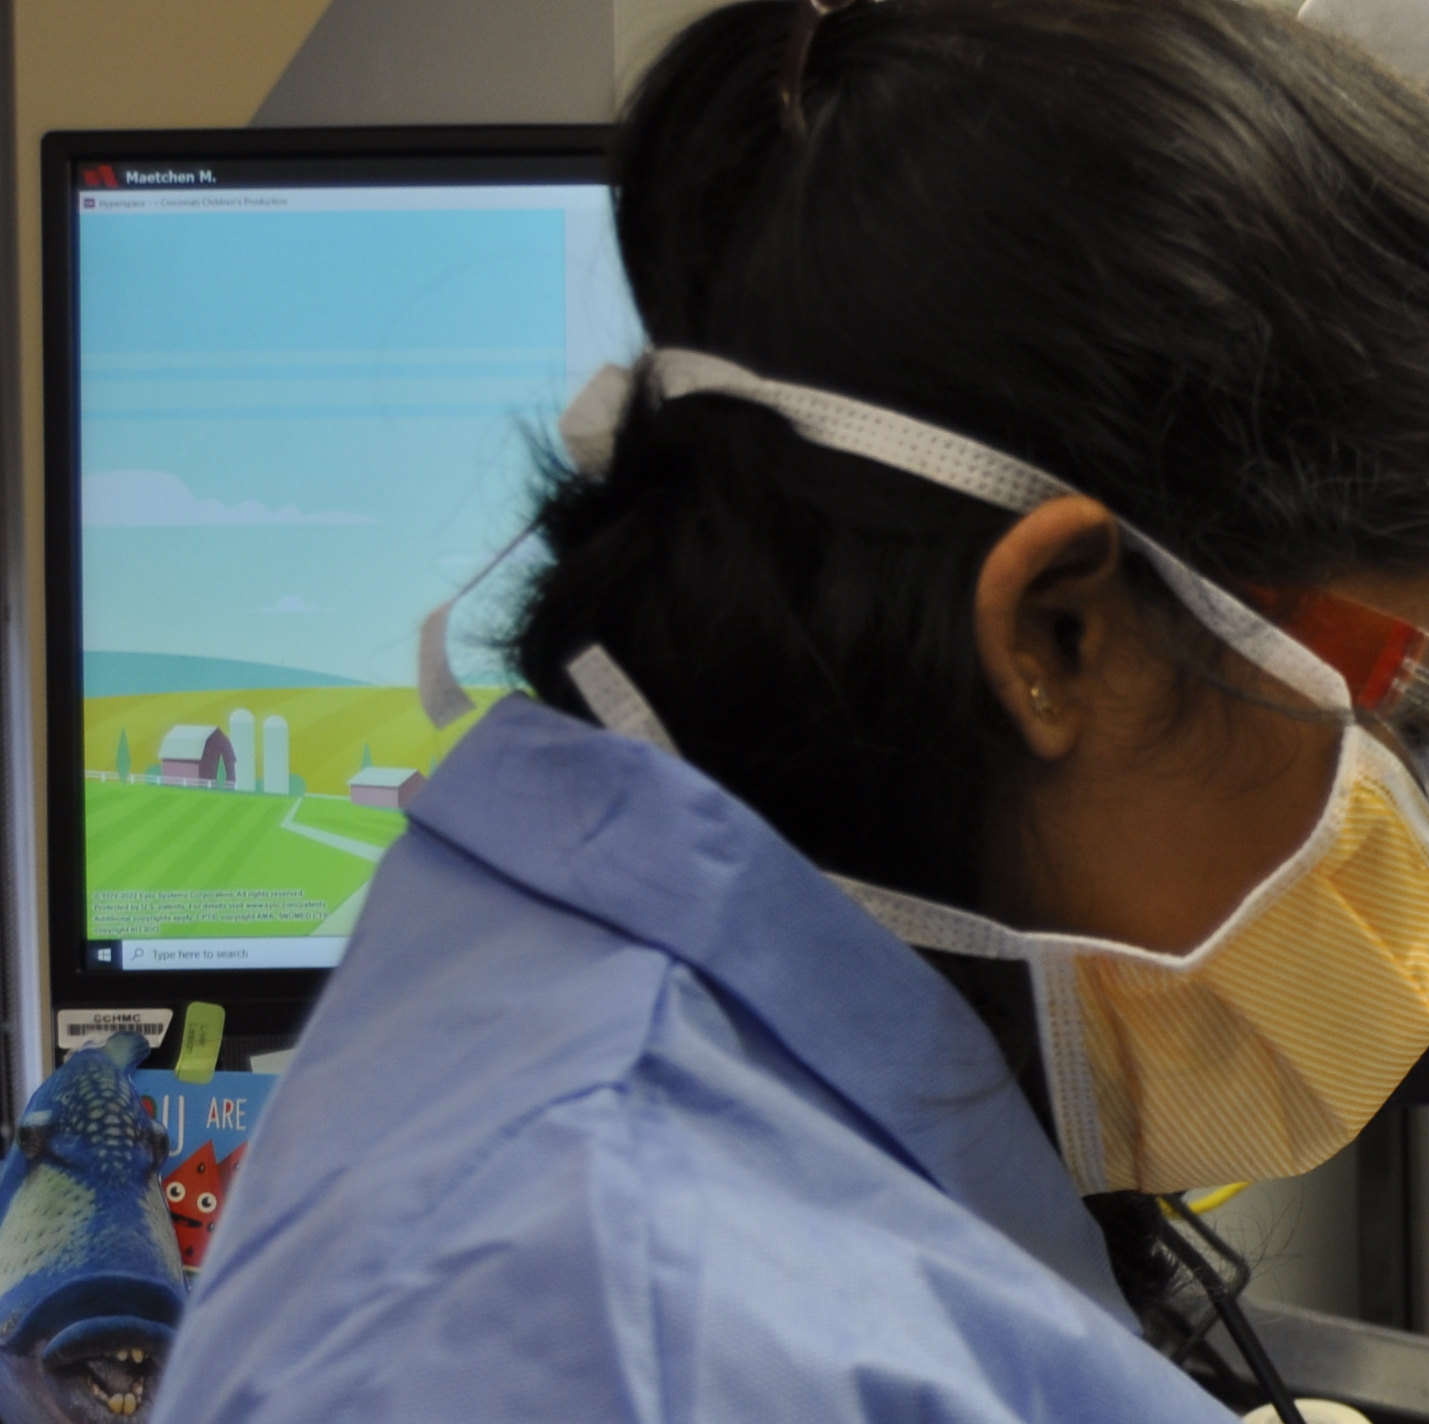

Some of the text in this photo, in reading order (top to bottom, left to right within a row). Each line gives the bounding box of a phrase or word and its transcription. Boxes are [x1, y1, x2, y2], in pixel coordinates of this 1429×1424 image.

[153, 948, 249, 961] Type here to search
[206, 1096, 248, 1130] ARE
